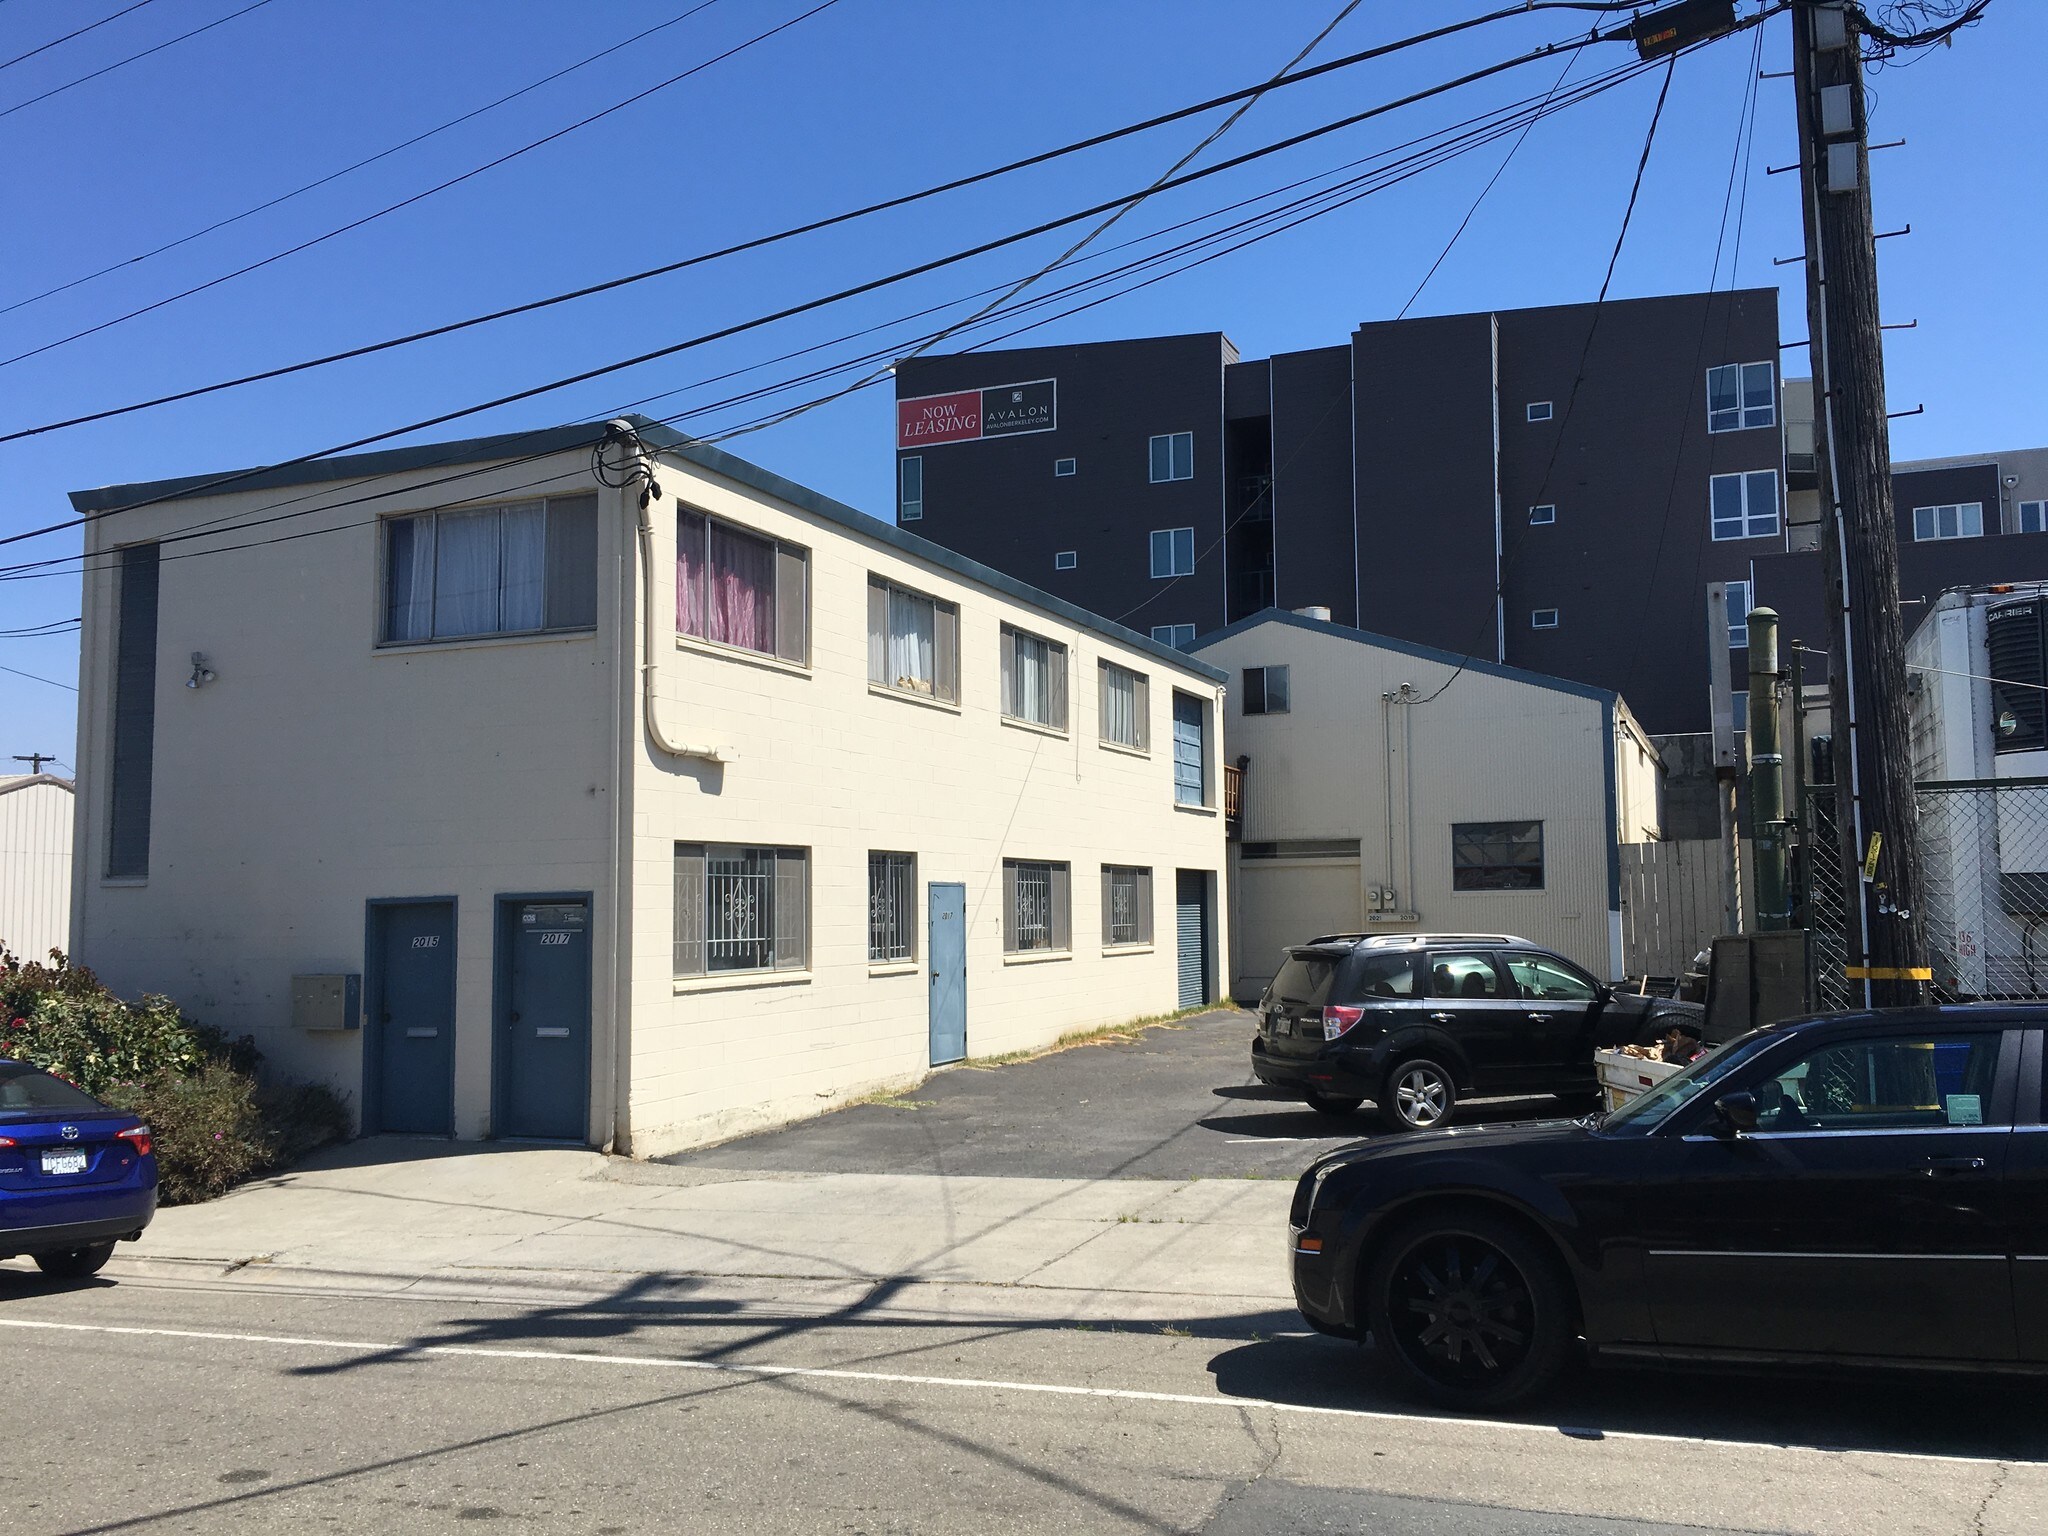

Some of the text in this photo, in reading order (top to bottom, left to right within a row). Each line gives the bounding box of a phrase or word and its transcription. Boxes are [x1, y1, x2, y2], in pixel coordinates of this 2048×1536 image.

[922, 403, 958, 420] NOW
[987, 405, 1048, 422] AVALON
[904, 414, 977, 437] LEASING
[985, 416, 1049, 430] AVALONBERKELEY.COM
[1988, 606, 2033, 622] CARRIER
[412, 936, 439, 948] 2015
[541, 932, 571, 945] 2017
